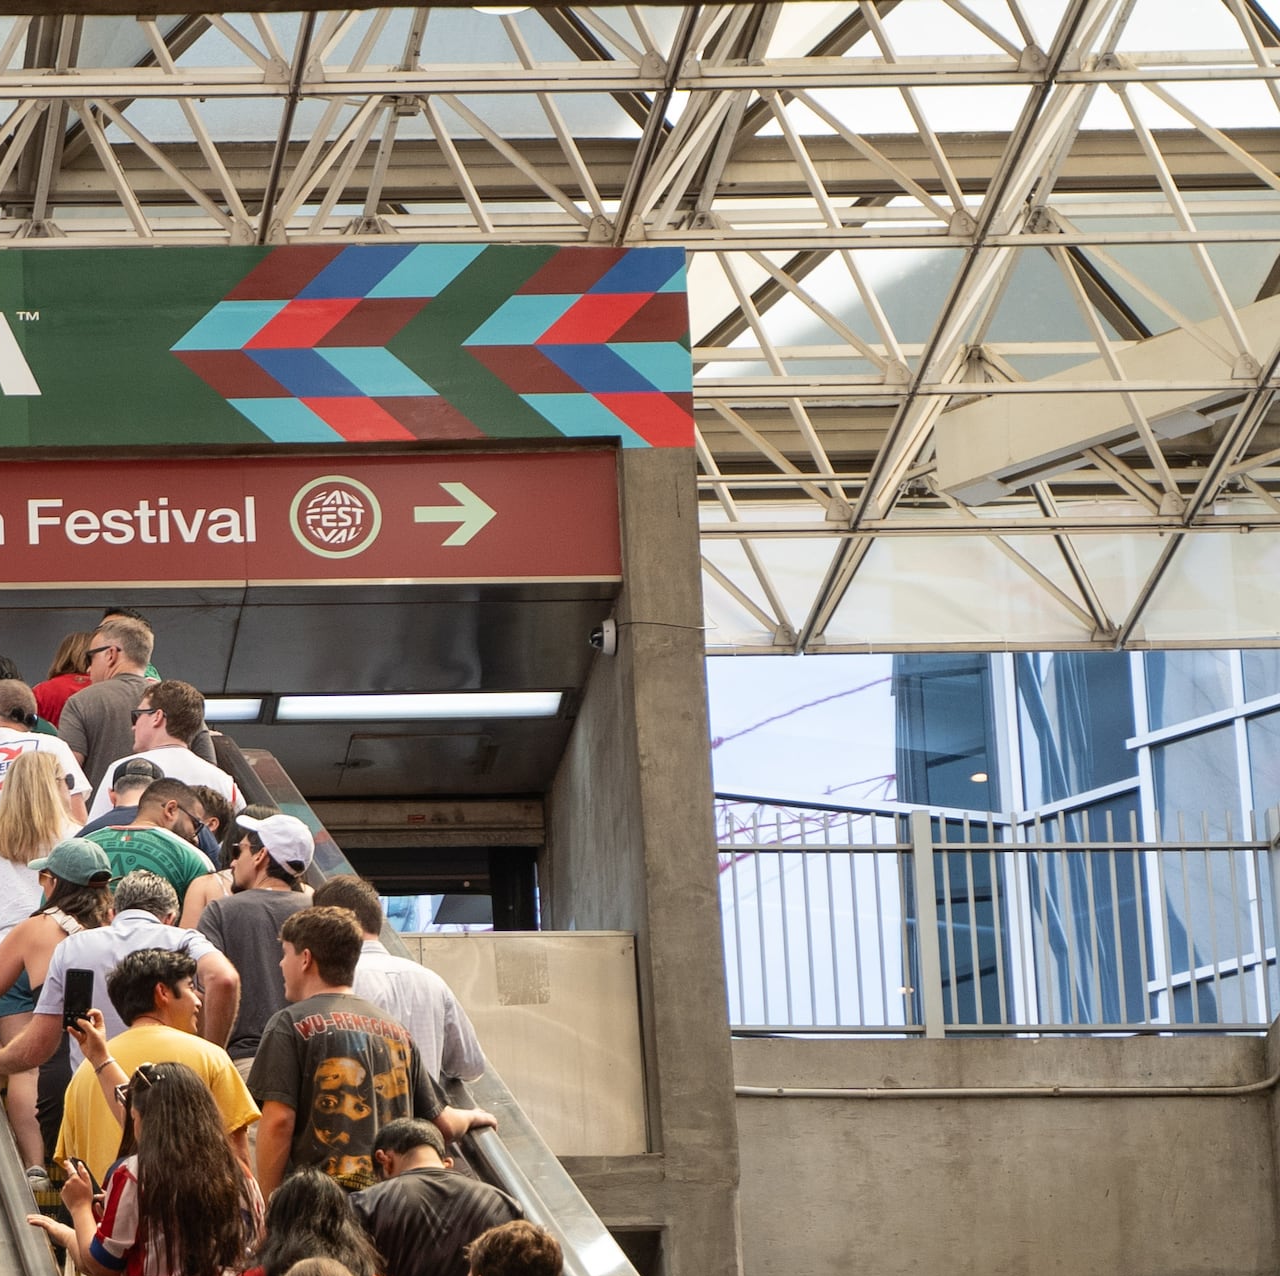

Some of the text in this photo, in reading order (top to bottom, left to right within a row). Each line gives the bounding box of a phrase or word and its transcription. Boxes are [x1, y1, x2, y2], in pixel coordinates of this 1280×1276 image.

[308, 490, 363, 508] FAN
[26, 496, 257, 545] Festival
[306, 506, 365, 527] FEST
